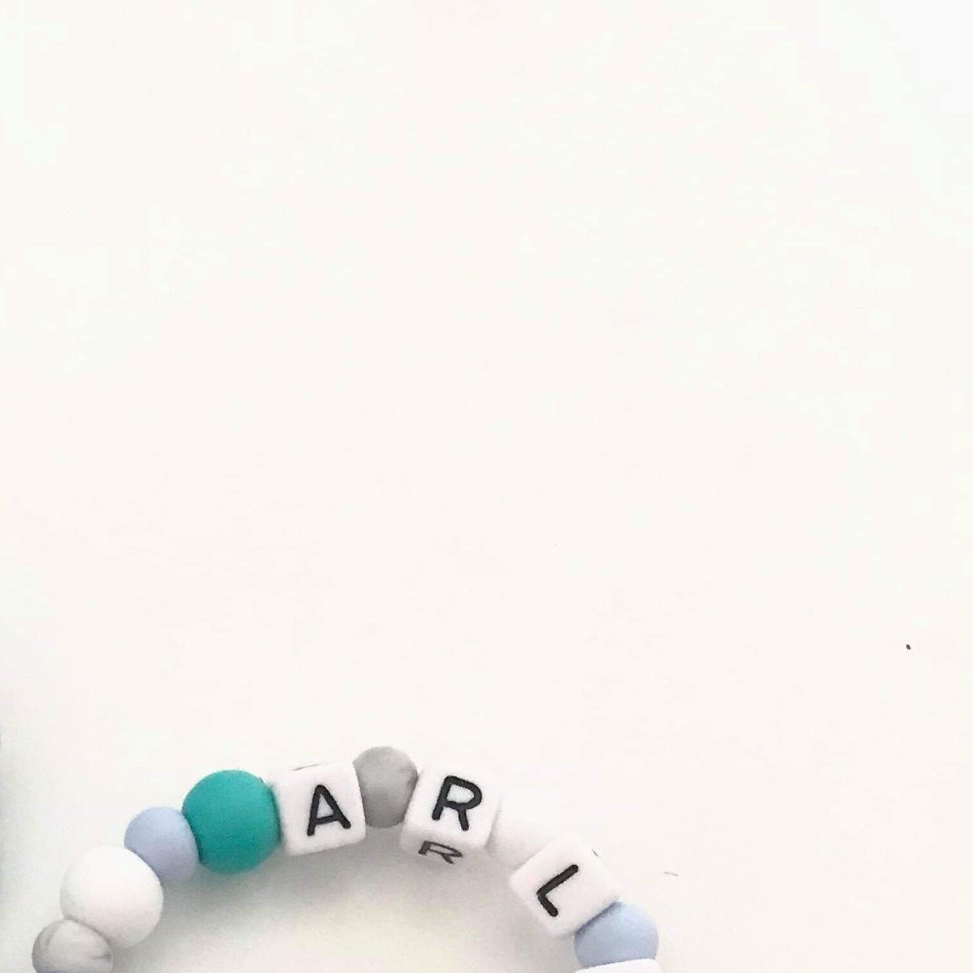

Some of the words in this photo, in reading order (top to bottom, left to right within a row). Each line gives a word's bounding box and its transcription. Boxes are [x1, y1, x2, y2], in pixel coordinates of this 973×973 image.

[306, 783, 352, 837] A
[431, 775, 484, 832] R
[536, 863, 579, 917] L
